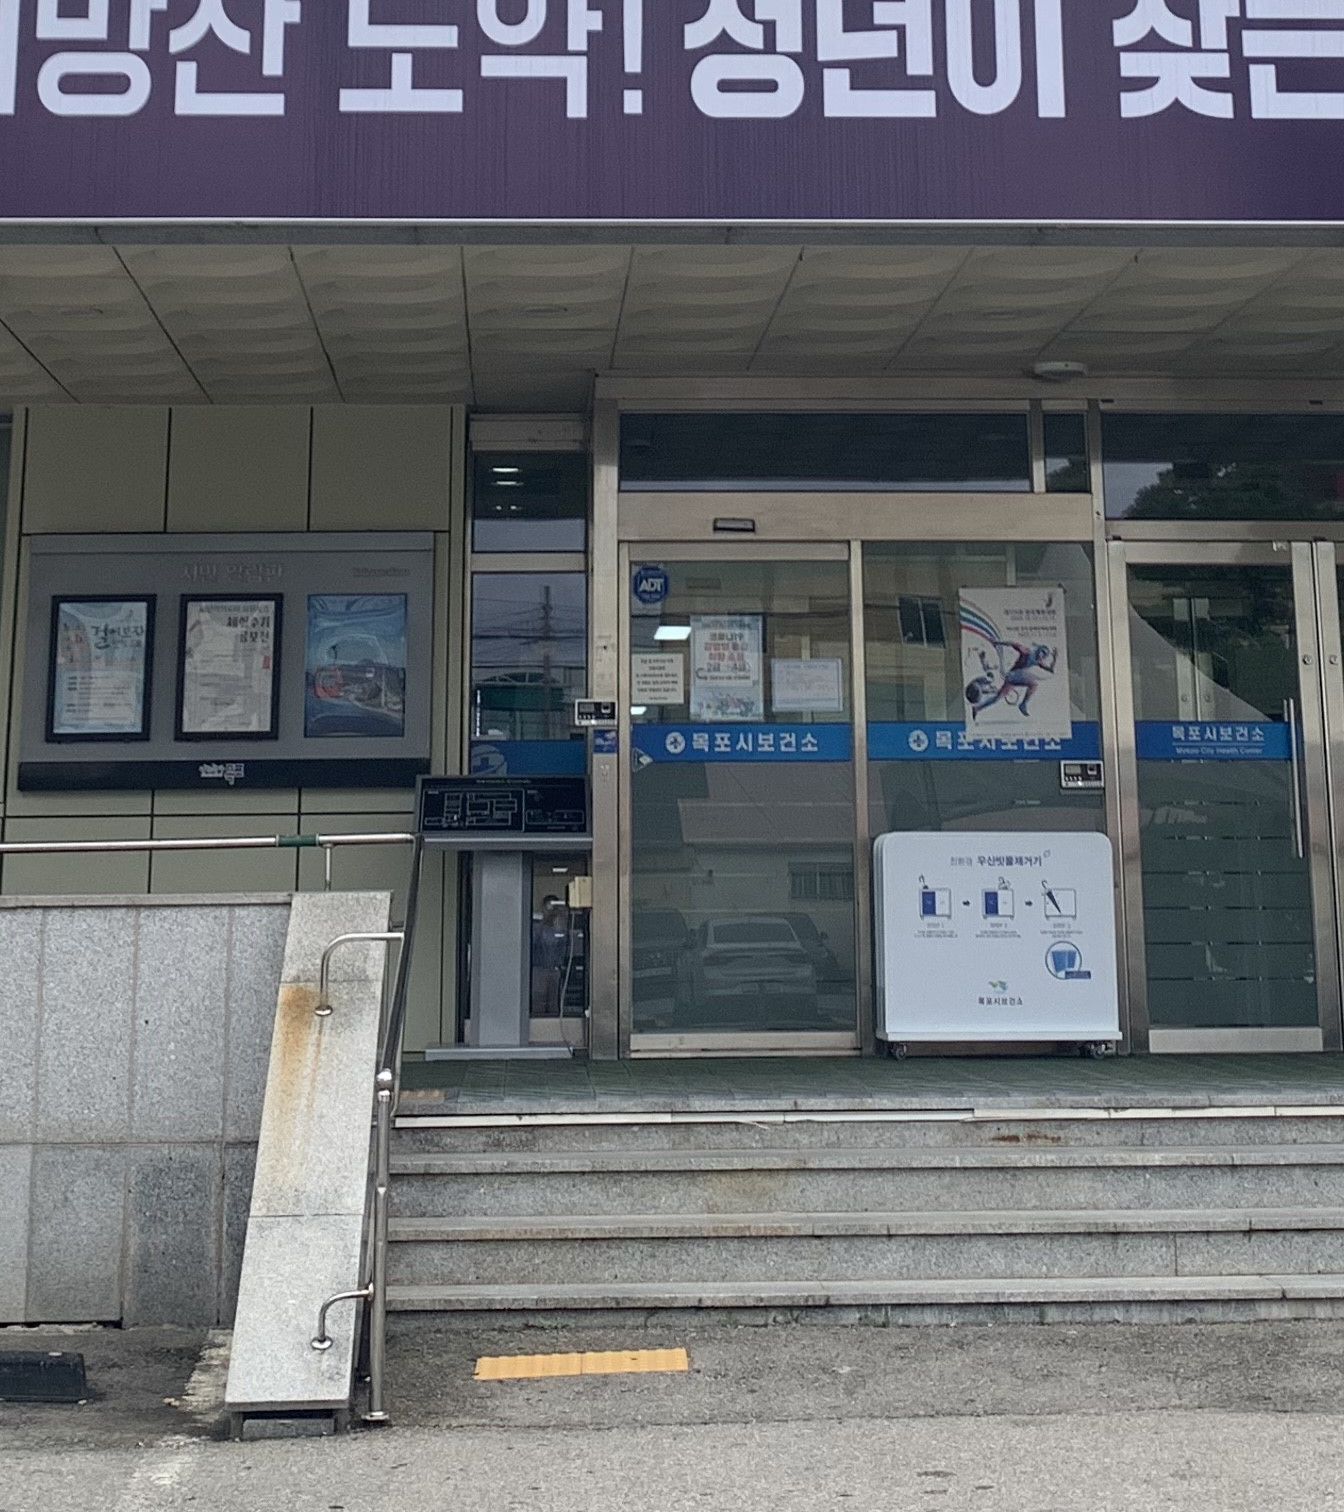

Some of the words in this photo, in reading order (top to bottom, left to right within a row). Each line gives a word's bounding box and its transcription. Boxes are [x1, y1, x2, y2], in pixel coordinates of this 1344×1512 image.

[639, 578, 664, 592] ADT
[1172, 726, 1265, 741] 목포시보건소
[692, 732, 818, 753] 목포시보건소
[977, 996, 1024, 1007] 목포시보건소
